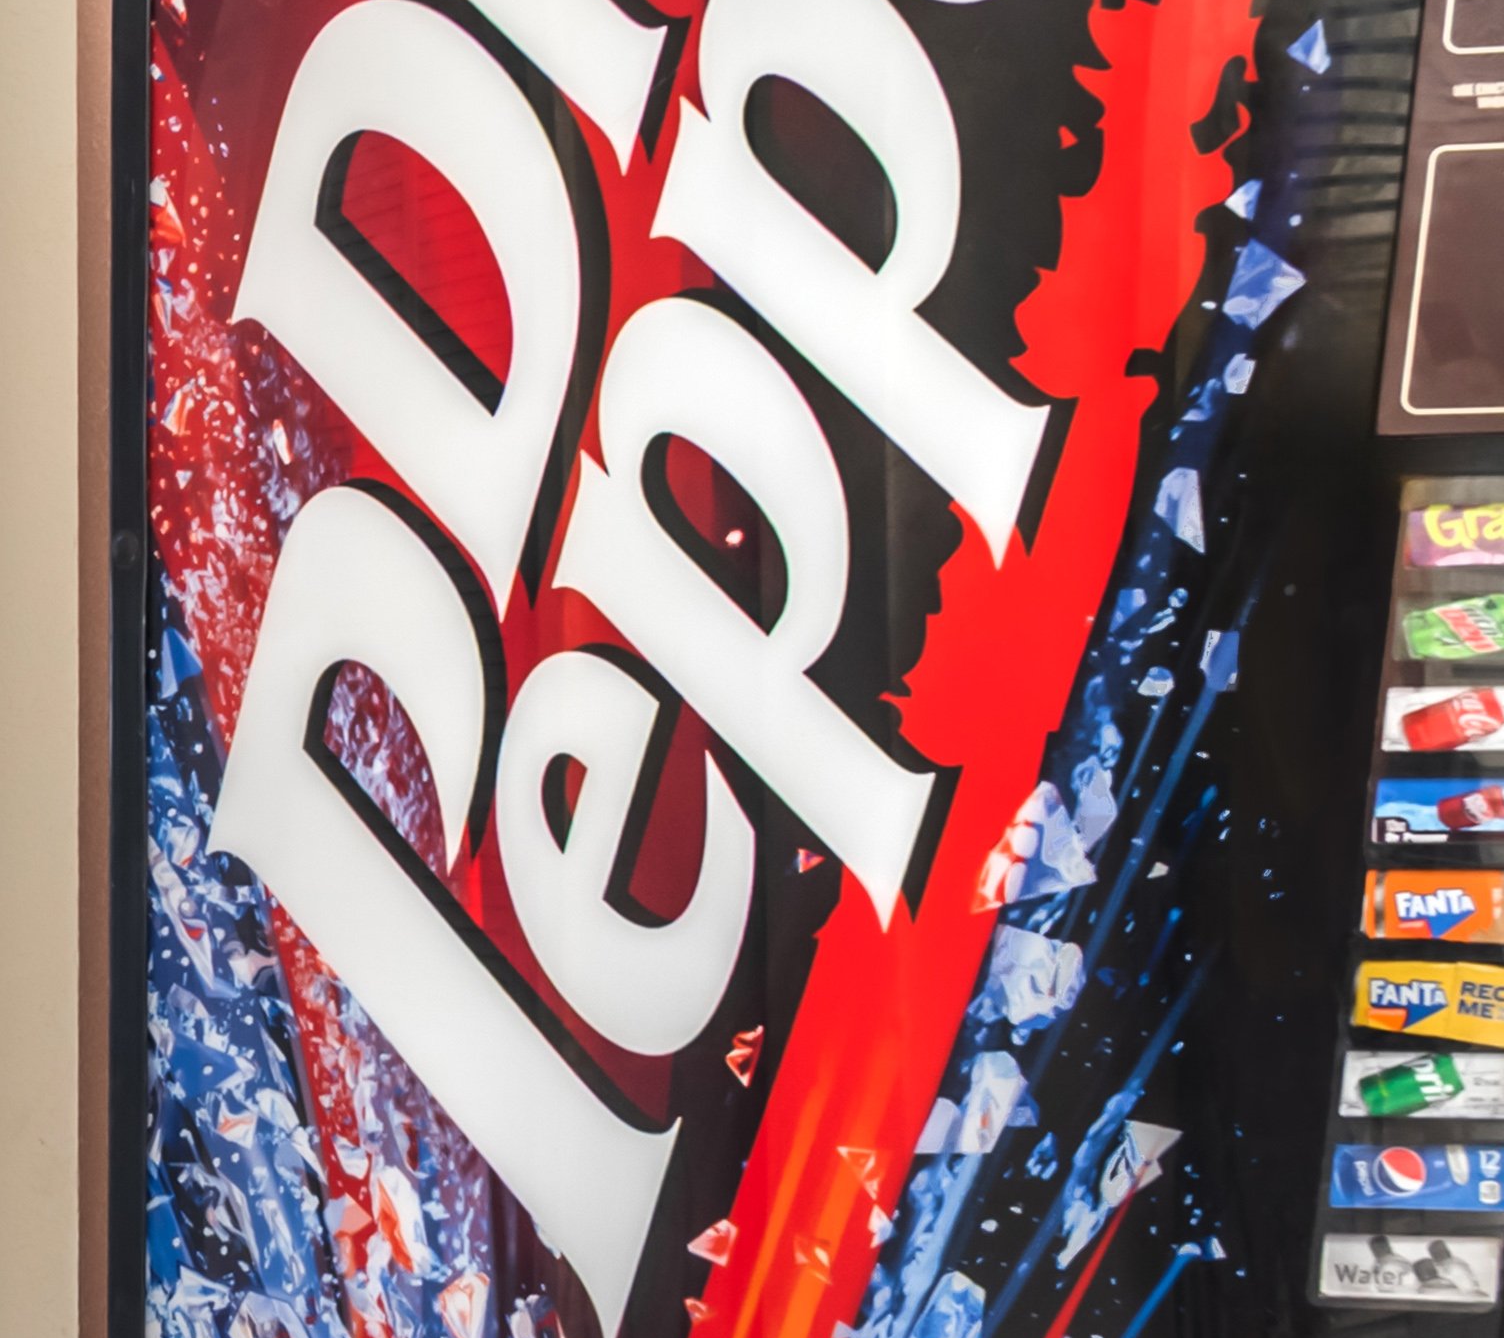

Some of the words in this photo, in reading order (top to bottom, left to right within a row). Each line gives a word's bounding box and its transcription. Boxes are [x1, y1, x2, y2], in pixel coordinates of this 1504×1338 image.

[1394, 887, 1476, 918] FANTA
[1369, 978, 1448, 1007] FANTA
[1457, 999, 1496, 1019] ME
[1478, 1149, 1502, 1172] 12
[1334, 1263, 1409, 1286] Water
